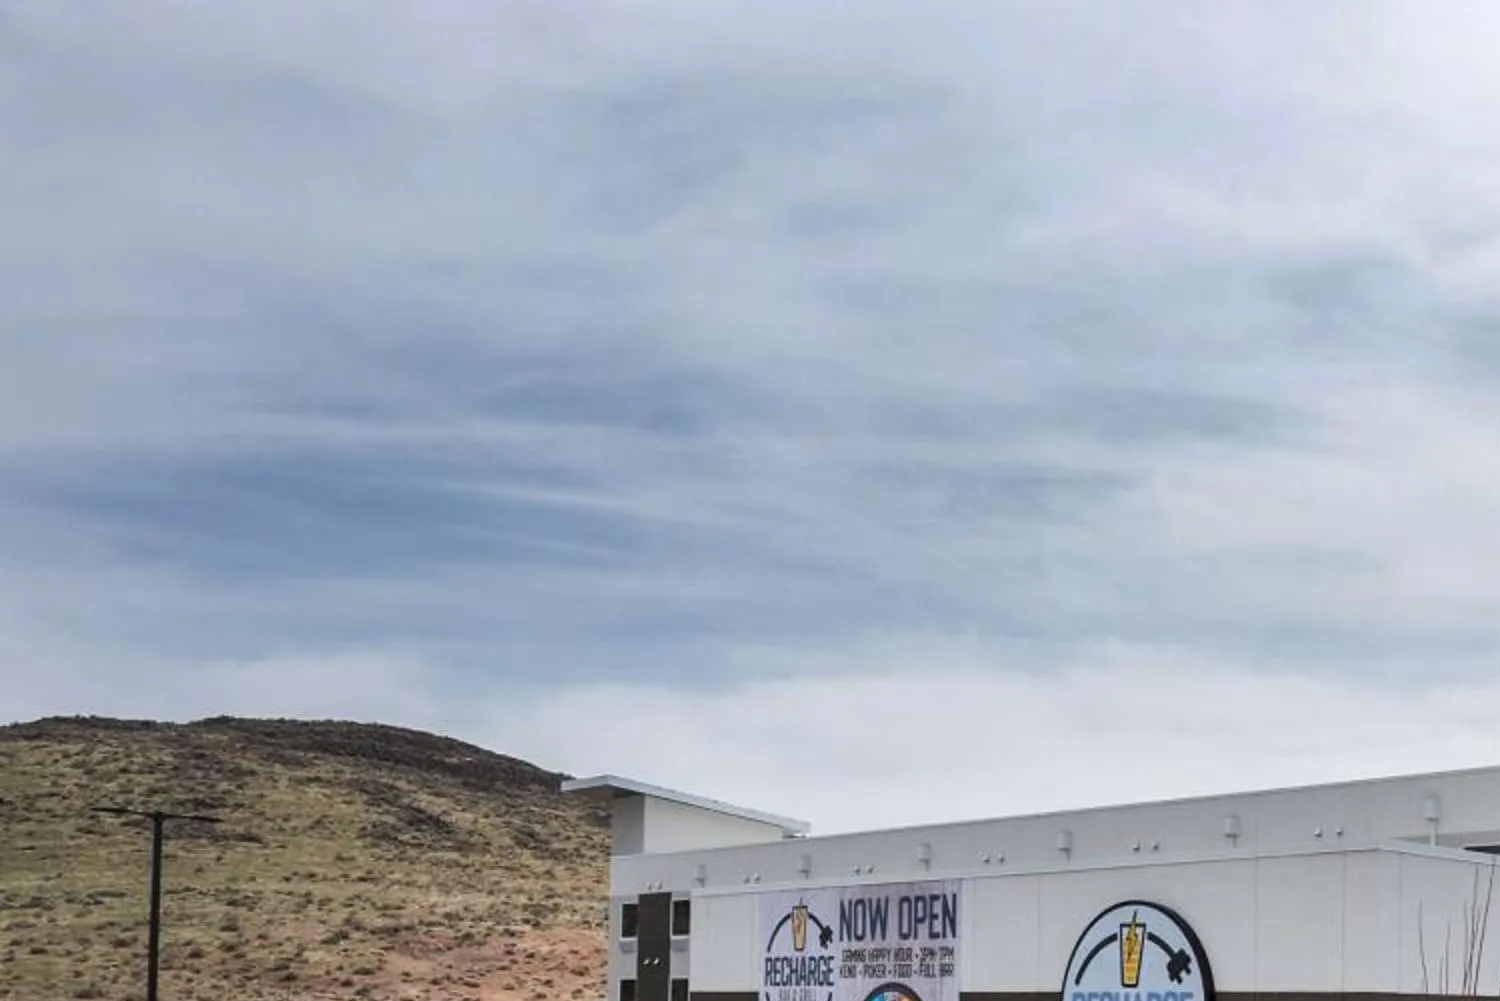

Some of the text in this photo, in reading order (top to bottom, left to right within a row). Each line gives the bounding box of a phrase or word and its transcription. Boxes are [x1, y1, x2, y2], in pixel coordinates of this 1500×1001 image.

[839, 893, 957, 942] NOW OPEN
[765, 956, 834, 987] RECHARGE
